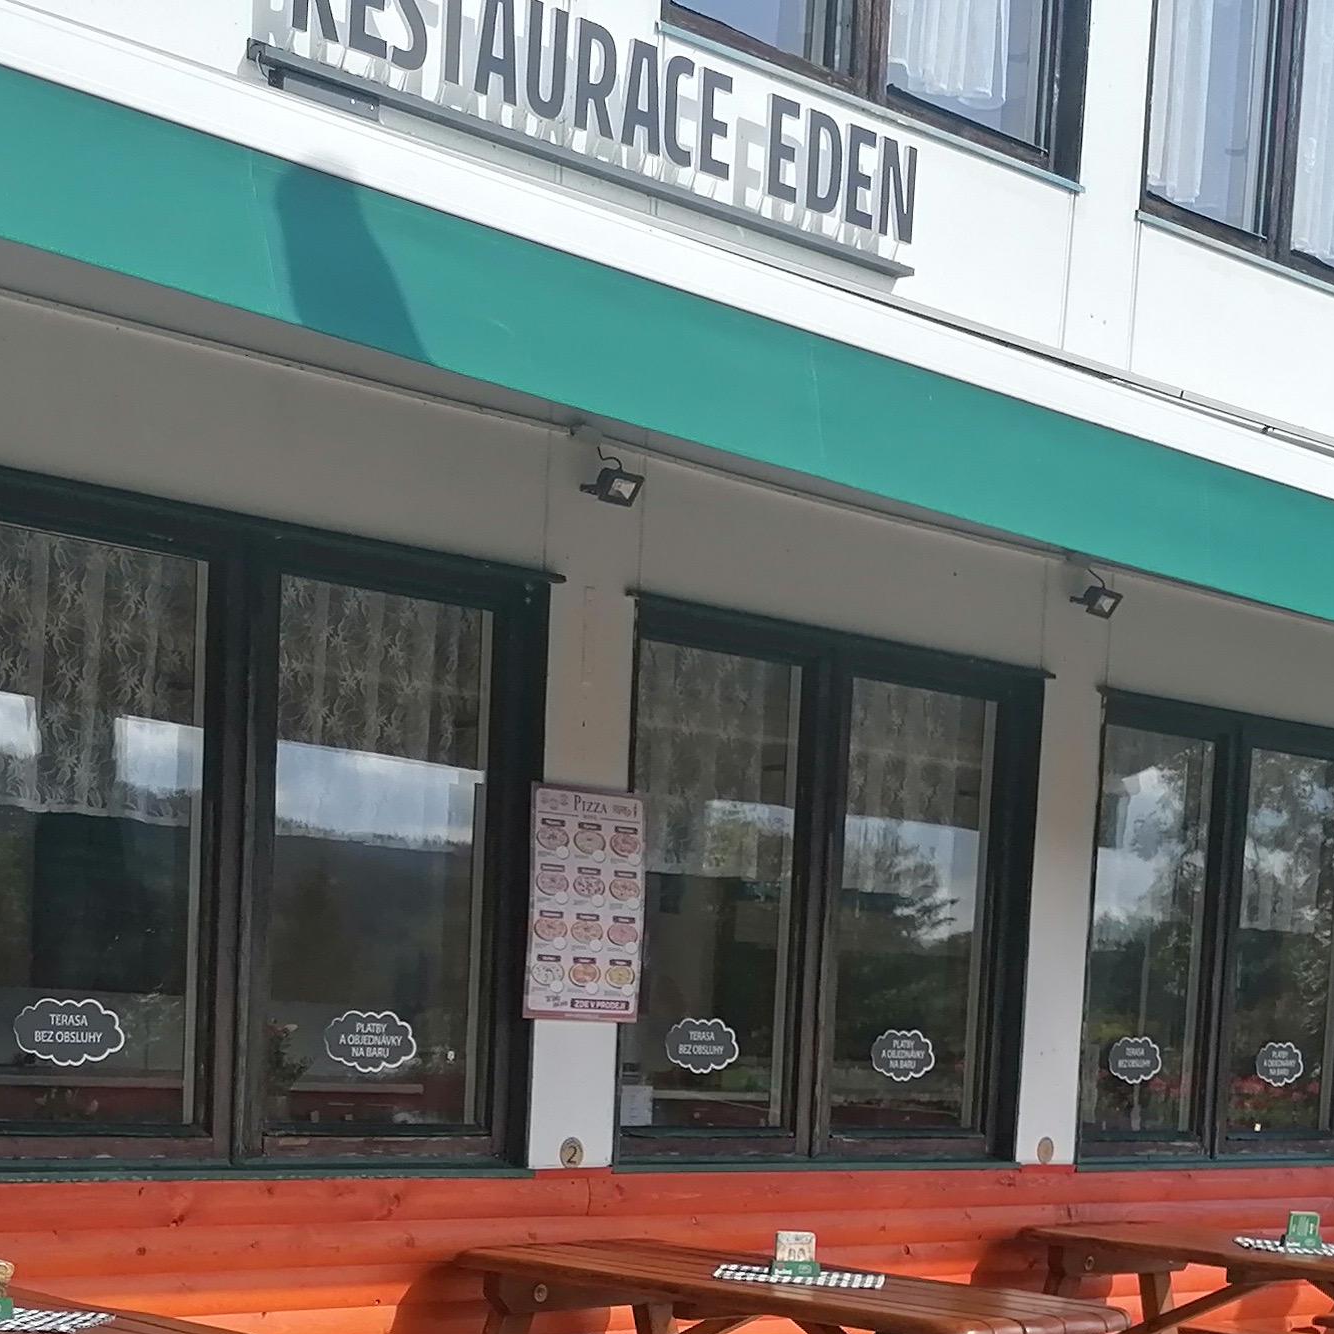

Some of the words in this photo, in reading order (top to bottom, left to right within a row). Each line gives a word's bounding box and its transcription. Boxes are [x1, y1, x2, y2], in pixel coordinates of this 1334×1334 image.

[767, 93, 918, 244] EDEN
[49, 1013, 88, 1027] TERASA
[355, 1022, 388, 1034] PLATBY
[34, 1030, 55, 1043] BEZ
[55, 1030, 103, 1043] OBSLUHY
[339, 1034, 347, 1045] A
[347, 1033, 403, 1046] OBJEDNÁVKY
[689, 1030, 715, 1041] TERASA
[351, 1046, 365, 1057] NA
[365, 1047, 390, 1058] BARU
